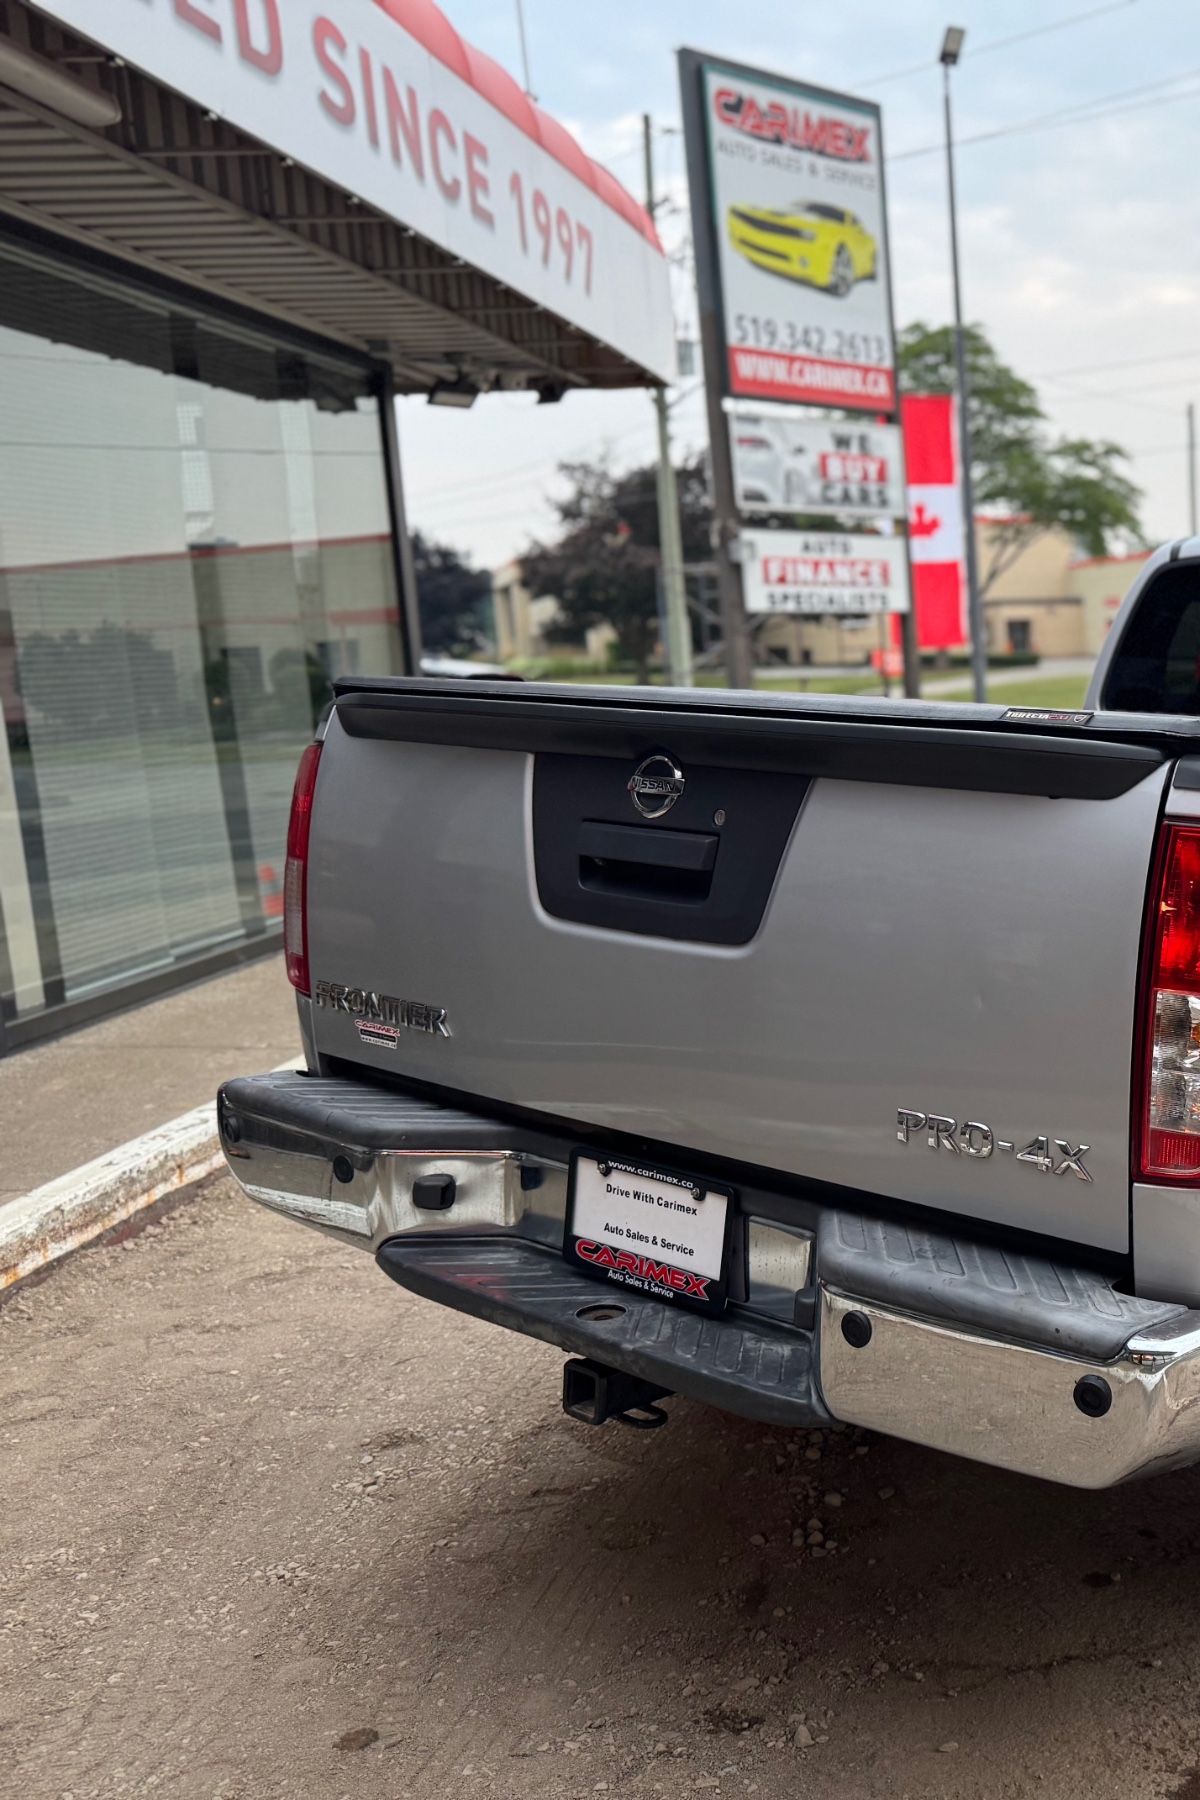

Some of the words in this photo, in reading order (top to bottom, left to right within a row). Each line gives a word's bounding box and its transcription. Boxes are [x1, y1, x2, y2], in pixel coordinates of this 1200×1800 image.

[714, 88, 872, 162] CARIMEX
[312, 14, 496, 224] SINCE
[509, 171, 593, 296] 1997
[718, 139, 756, 164] AUTO
[761, 148, 802, 173] SALES
[823, 167, 877, 190] SERVICE
[736, 354, 890, 396] WWW.CARIMEX.CA
[833, 434, 869, 452] WE
[823, 455, 886, 483] BUY
[822, 485, 888, 507] CARS
[763, 558, 888, 586] FINANCE
[632, 777, 675, 791] NISSAN
[316, 980, 451, 1037] FRONTIER
[355, 1020, 400, 1036] CARIMEX
[897, 1107, 1093, 1182] PRO-4X
[608, 1160, 694, 1189] www.carimex.ca
[606, 1183, 631, 1199] Drive
[633, 1190, 655, 1205] With
[656, 1197, 698, 1216] Carimex
[604, 1223, 624, 1236] Auto
[625, 1229, 650, 1244] Sales
[651, 1236, 658, 1246] &
[660, 1238, 695, 1257] Service
[575, 1238, 711, 1300] CARIMEX
[607, 1269, 624, 1283] Auto
[625, 1275, 643, 1288] Sales
[643, 1281, 650, 1290] &
[650, 1284, 675, 1299] Service
